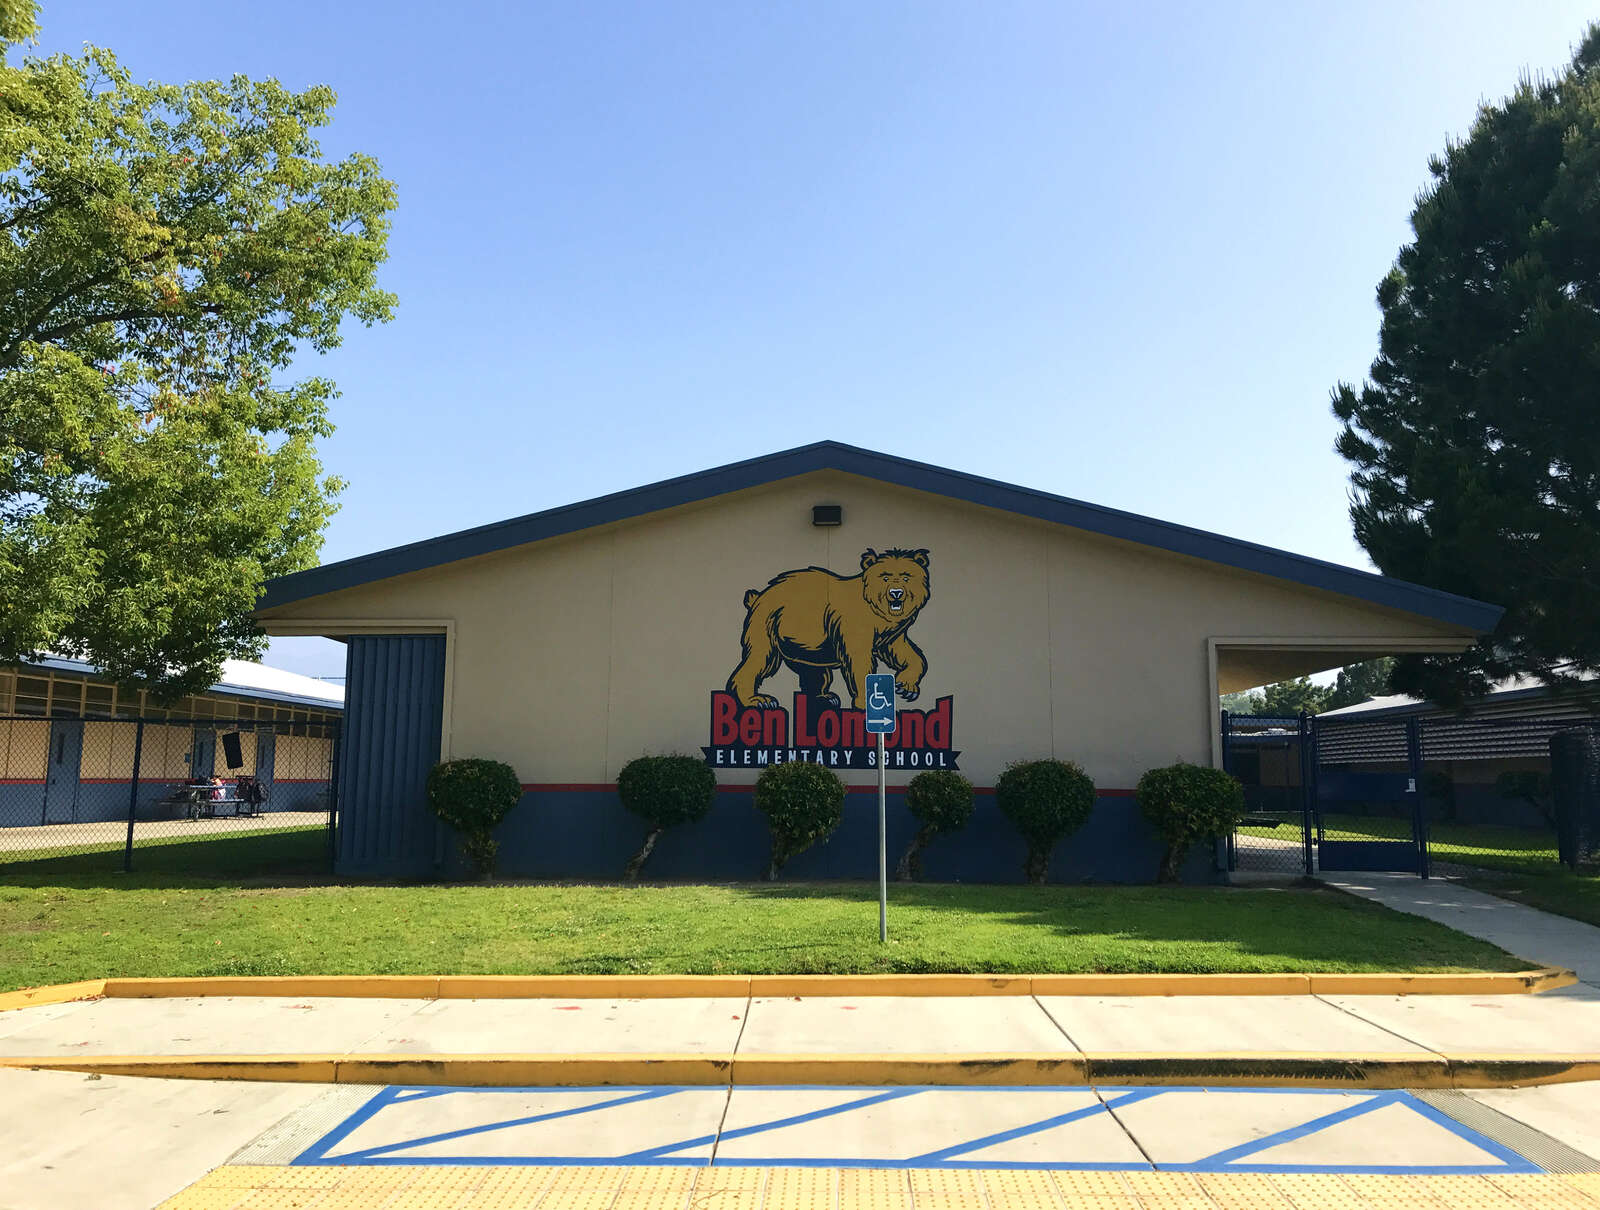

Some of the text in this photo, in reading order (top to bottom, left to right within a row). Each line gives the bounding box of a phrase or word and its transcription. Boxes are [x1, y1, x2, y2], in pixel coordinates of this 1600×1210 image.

[713, 693, 786, 746] Ben
[716, 749, 946, 766] ELEMENTARY SCHOOL
